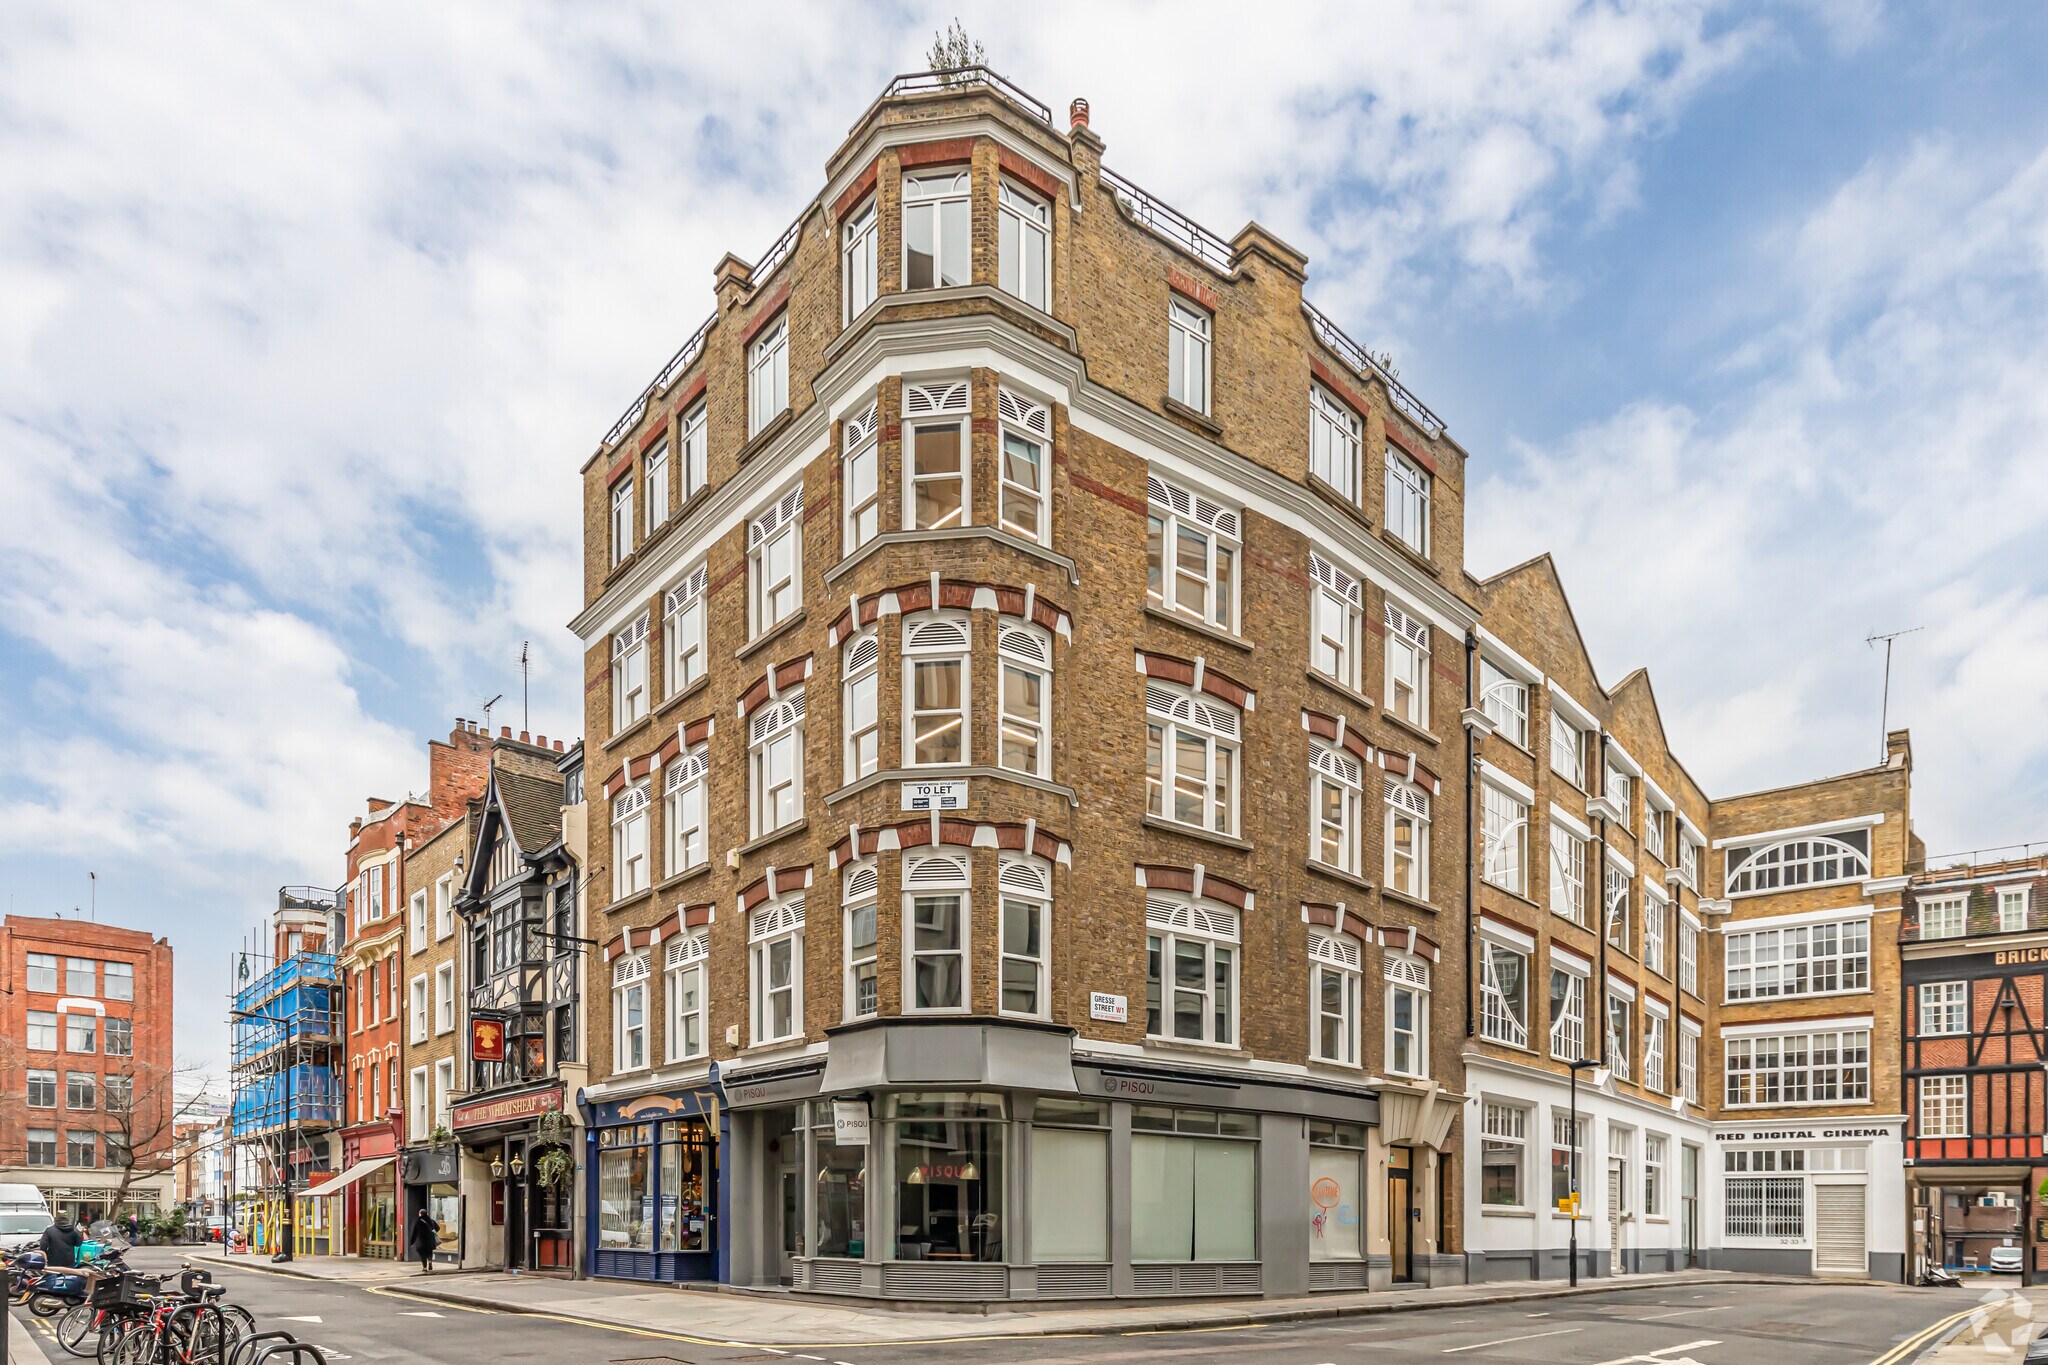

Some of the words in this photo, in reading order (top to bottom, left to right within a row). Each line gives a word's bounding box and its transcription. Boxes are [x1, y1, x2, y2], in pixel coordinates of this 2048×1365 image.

[917, 786, 931, 795] TO
[934, 785, 952, 794] LET
[1094, 995, 1115, 1005] GRESSE
[1094, 1003, 1115, 1013] STREET
[1116, 1006, 1125, 1014] W1
[1121, 1080, 1154, 1094] PISQU
[743, 1087, 766, 1099] PISQU
[474, 1106, 488, 1120] THE
[488, 1097, 537, 1117] WHEATSHEAF
[846, 1120, 868, 1128] PISQU
[1715, 1133, 1746, 1141] RED
[1753, 1131, 1816, 1140] DIGITAL
[1823, 1128, 1890, 1138] CINEMA
